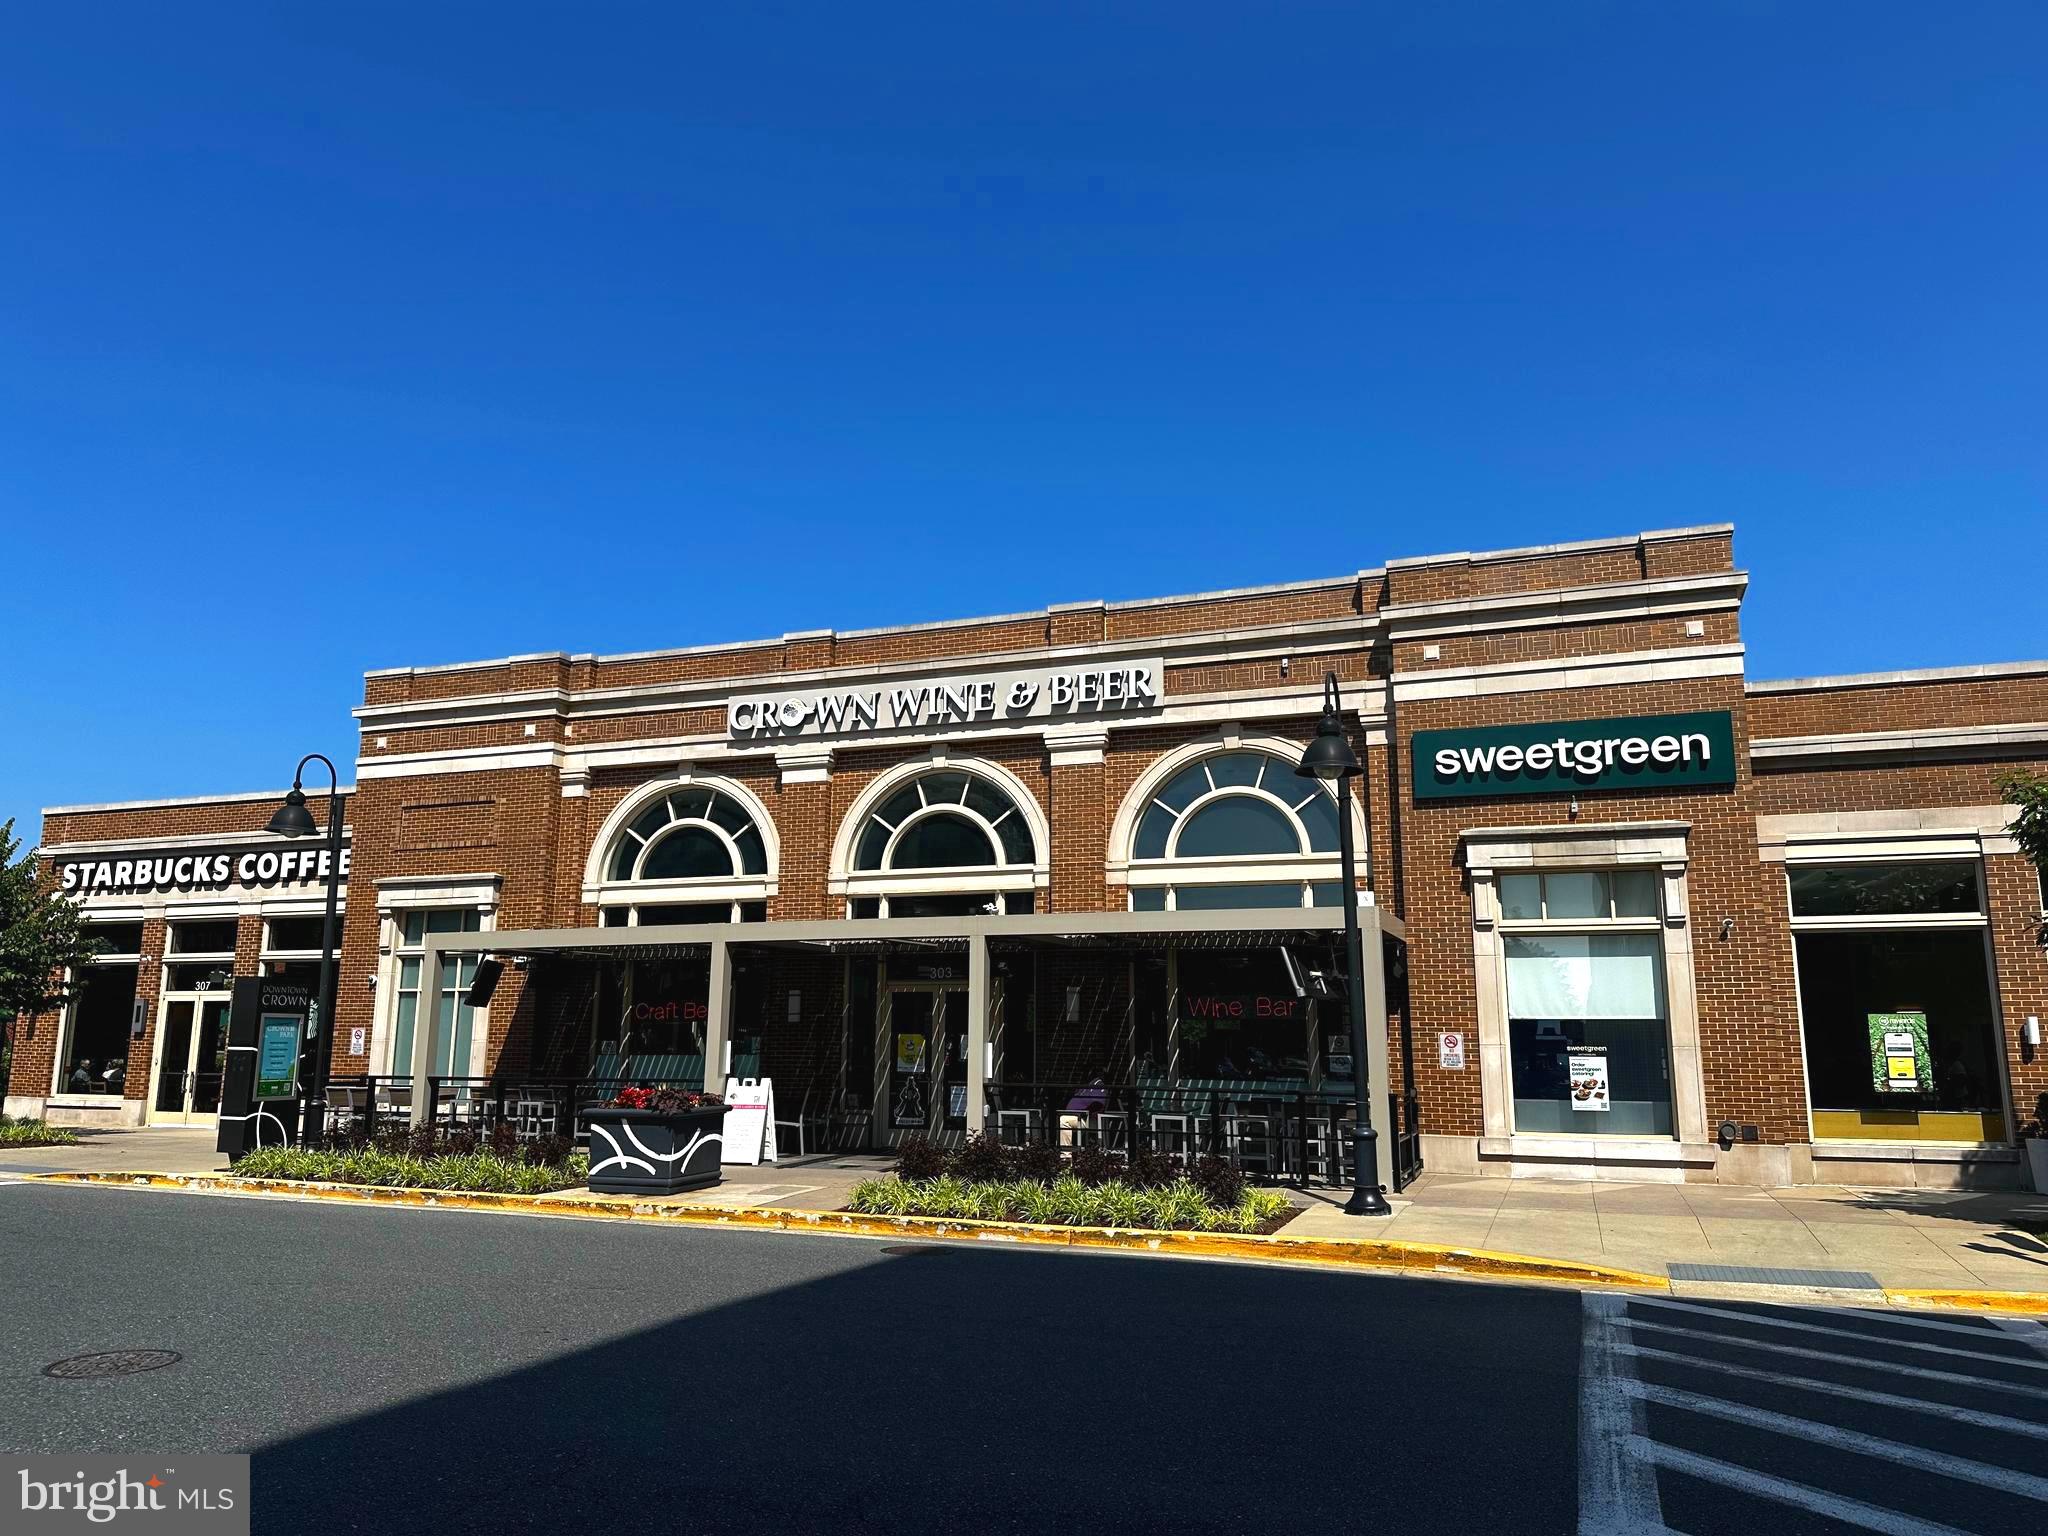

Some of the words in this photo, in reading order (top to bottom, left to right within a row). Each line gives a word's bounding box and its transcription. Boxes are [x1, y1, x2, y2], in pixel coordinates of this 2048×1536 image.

[730, 692, 878, 730] CROWN
[889, 682, 995, 717] WINE
[1007, 681, 1038, 708] &
[1050, 667, 1154, 705] BEER
[1435, 733, 1710, 775] sweetgreen
[62, 855, 230, 889] STARBUCKS
[239, 848, 351, 880] COFFEE
[930, 967, 952, 979] 303
[195, 981, 211, 991] 307
[263, 985, 308, 994] DOWNTOWN
[262, 995, 307, 1006] CROWN
[1187, 997, 1243, 1018] Wine
[1256, 997, 1297, 1016] Bar
[636, 1001, 679, 1020] Craft
[684, 1002, 708, 1019] Be
